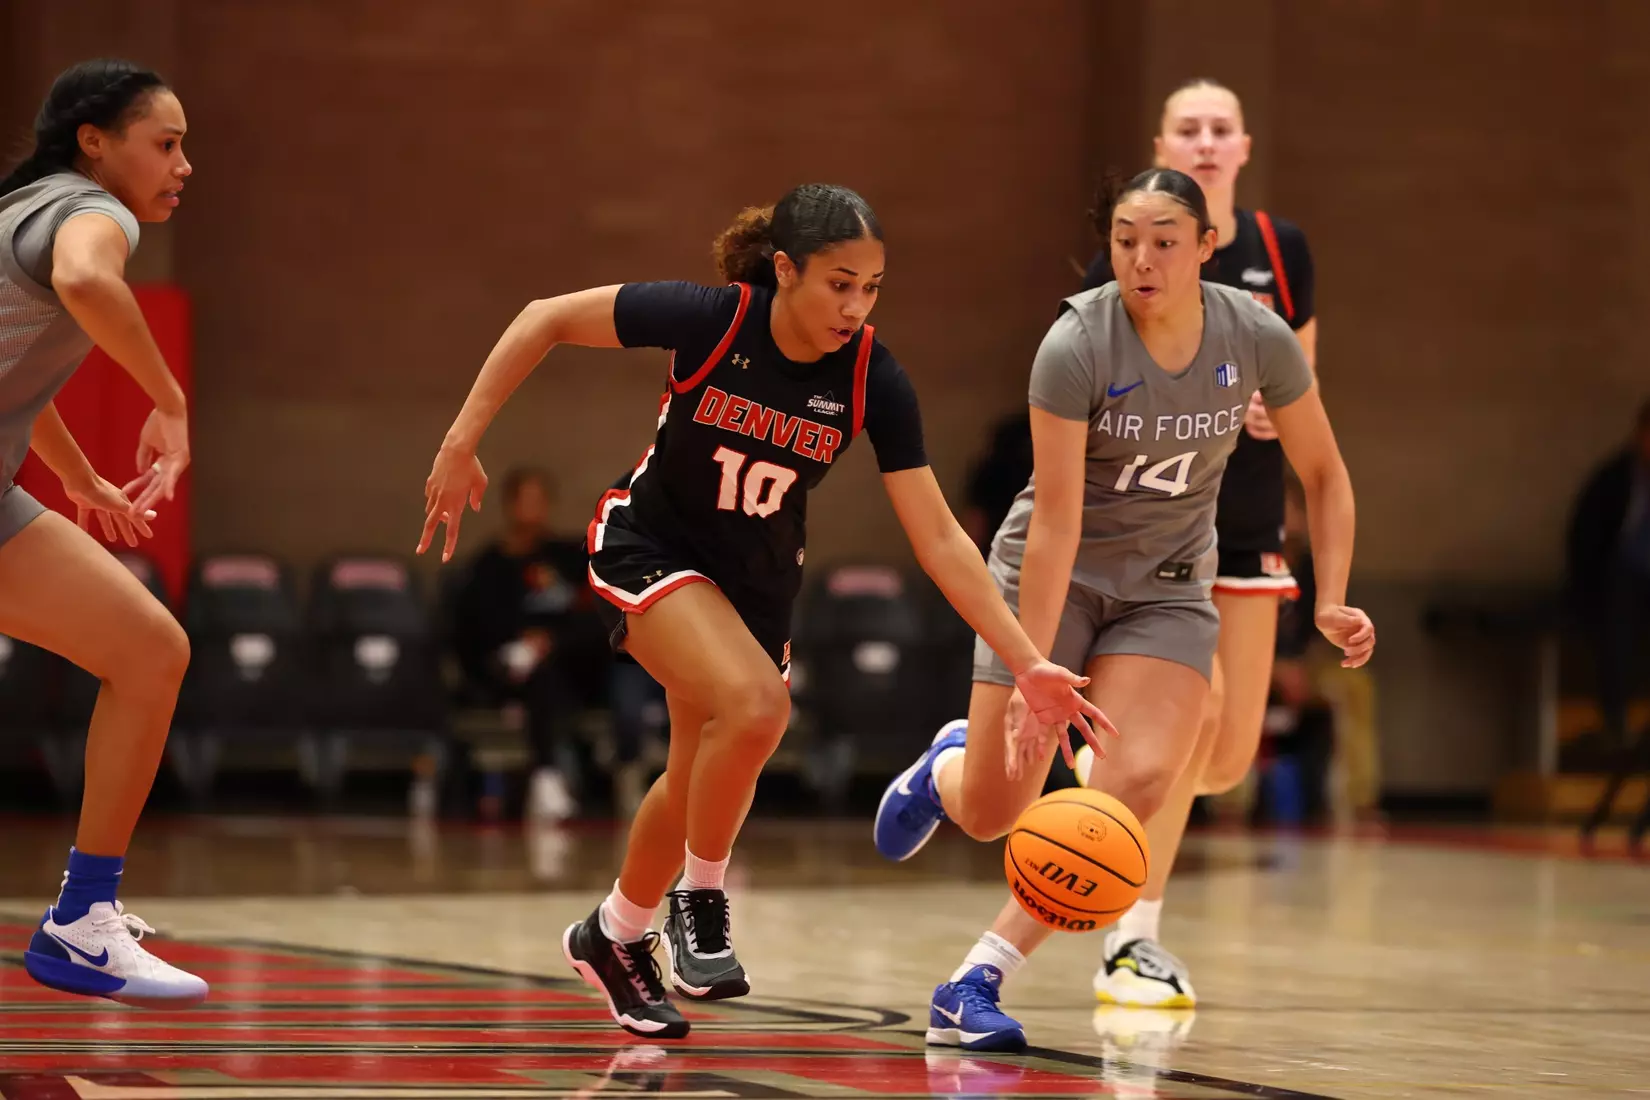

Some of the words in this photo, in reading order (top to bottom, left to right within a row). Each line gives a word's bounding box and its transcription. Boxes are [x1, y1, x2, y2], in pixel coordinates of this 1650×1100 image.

[693, 385, 843, 464] DENVER
[806, 398, 846, 414] SUMMIT
[813, 408, 836, 416] LEAGUE
[1097, 409, 1144, 441] AIR
[1154, 404, 1244, 442] FORCE
[711, 444, 799, 519] 10
[1113, 450, 1199, 497] 14
[1038, 860, 1099, 898] EVO
